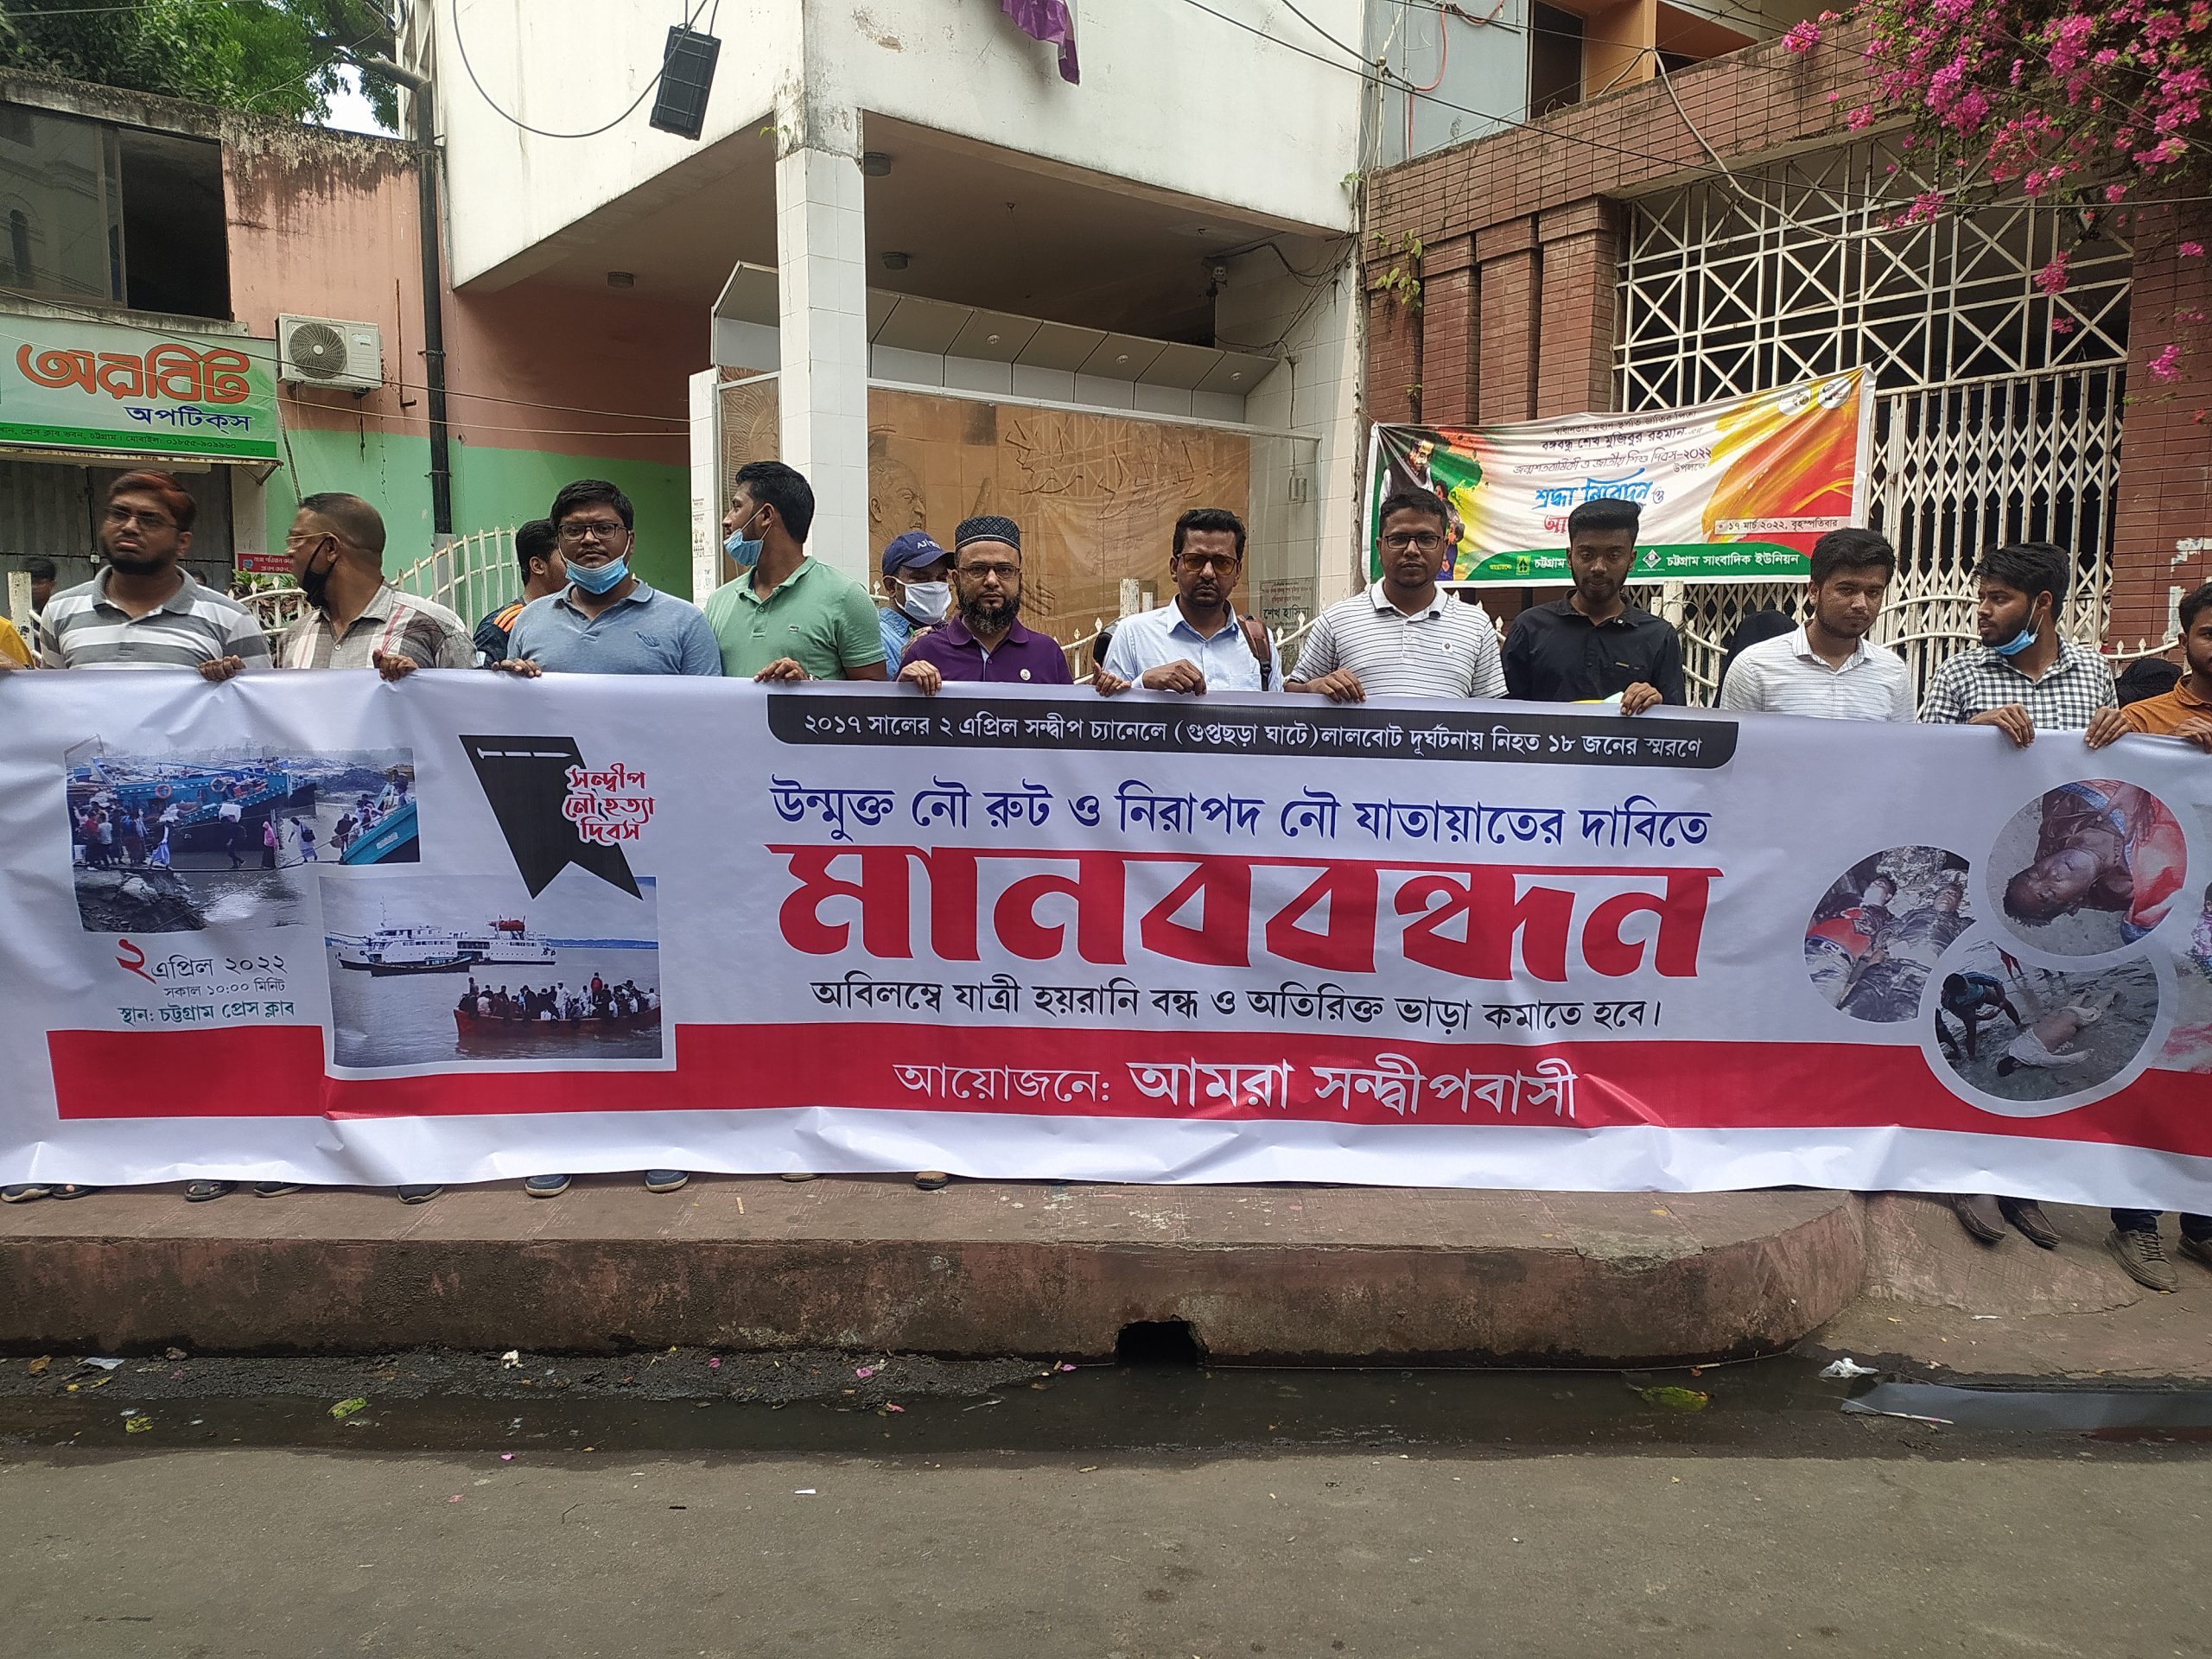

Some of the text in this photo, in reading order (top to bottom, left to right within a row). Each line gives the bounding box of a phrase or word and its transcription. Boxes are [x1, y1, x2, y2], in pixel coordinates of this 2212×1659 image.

[16, 343, 251, 404] অরবিট
[1541, 439, 1573, 452] বঙ্গবন্ধু
[1578, 435, 1600, 448] শেখ
[1605, 430, 1643, 449] মুজিবুর
[1648, 427, 1686, 442] রহমান
[1532, 486, 1579, 510] শ্রদ্ধা
[1728, 521, 1740, 531] ১৭
[1744, 518, 1758, 530] মার্চ
[1791, 517, 1838, 531] বৃহস্পতিবার
[1667, 550, 1800, 567] চট্টগ্রাম সাংবাদিক ইউনিয়ন
[804, 715, 862, 735] ২০১৭
[868, 715, 931, 736] সালের
[939, 717, 953, 738] ২
[959, 711, 1019, 738] এপ্রিল
[1026, 713, 1084, 741] সন্দ্বীপ
[1090, 722, 1167, 742] চ্যানেলে
[1491, 724, 1541, 754] নিহত
[1548, 734, 1576, 753] ১৮
[1581, 734, 1638, 757] জনের
[1643, 736, 1703, 759] স্মরণে
[569, 762, 646, 792] সন্দ্বীপ
[565, 791, 656, 823] নৌ হত্যা
[771, 773, 1713, 848] উন্মুক্ত নৌ রুট ও নিরাপদ নৌ যাতায়াতের দাবিতে
[580, 816, 641, 842] দিবস
[763, 843, 1725, 982] মানববন্ধন
[115, 938, 289, 985] ২ এপ্রিল ২০২২
[163, 977, 286, 1000] সকাল ১০:০০ মিনিট
[810, 969, 944, 1014] অবিলম্বে
[952, 973, 1022, 1014] যাত্রী
[1032, 976, 1141, 1018] হয়রানি
[1148, 988, 1198, 1020] বন্ধ
[1211, 990, 1236, 1015] ও
[1246, 981, 1385, 1024] অতিরিক্ত
[1395, 994, 1472, 1035] ভাড়া
[1482, 999, 1585, 1033] কমাতে
[118, 1000, 295, 1027] স্থান: চট্টগ্রাম প্রেস ক্লাব
[893, 1052, 1580, 1120] আয়োজনে: আমরা সন্দ্বীপবাসী
